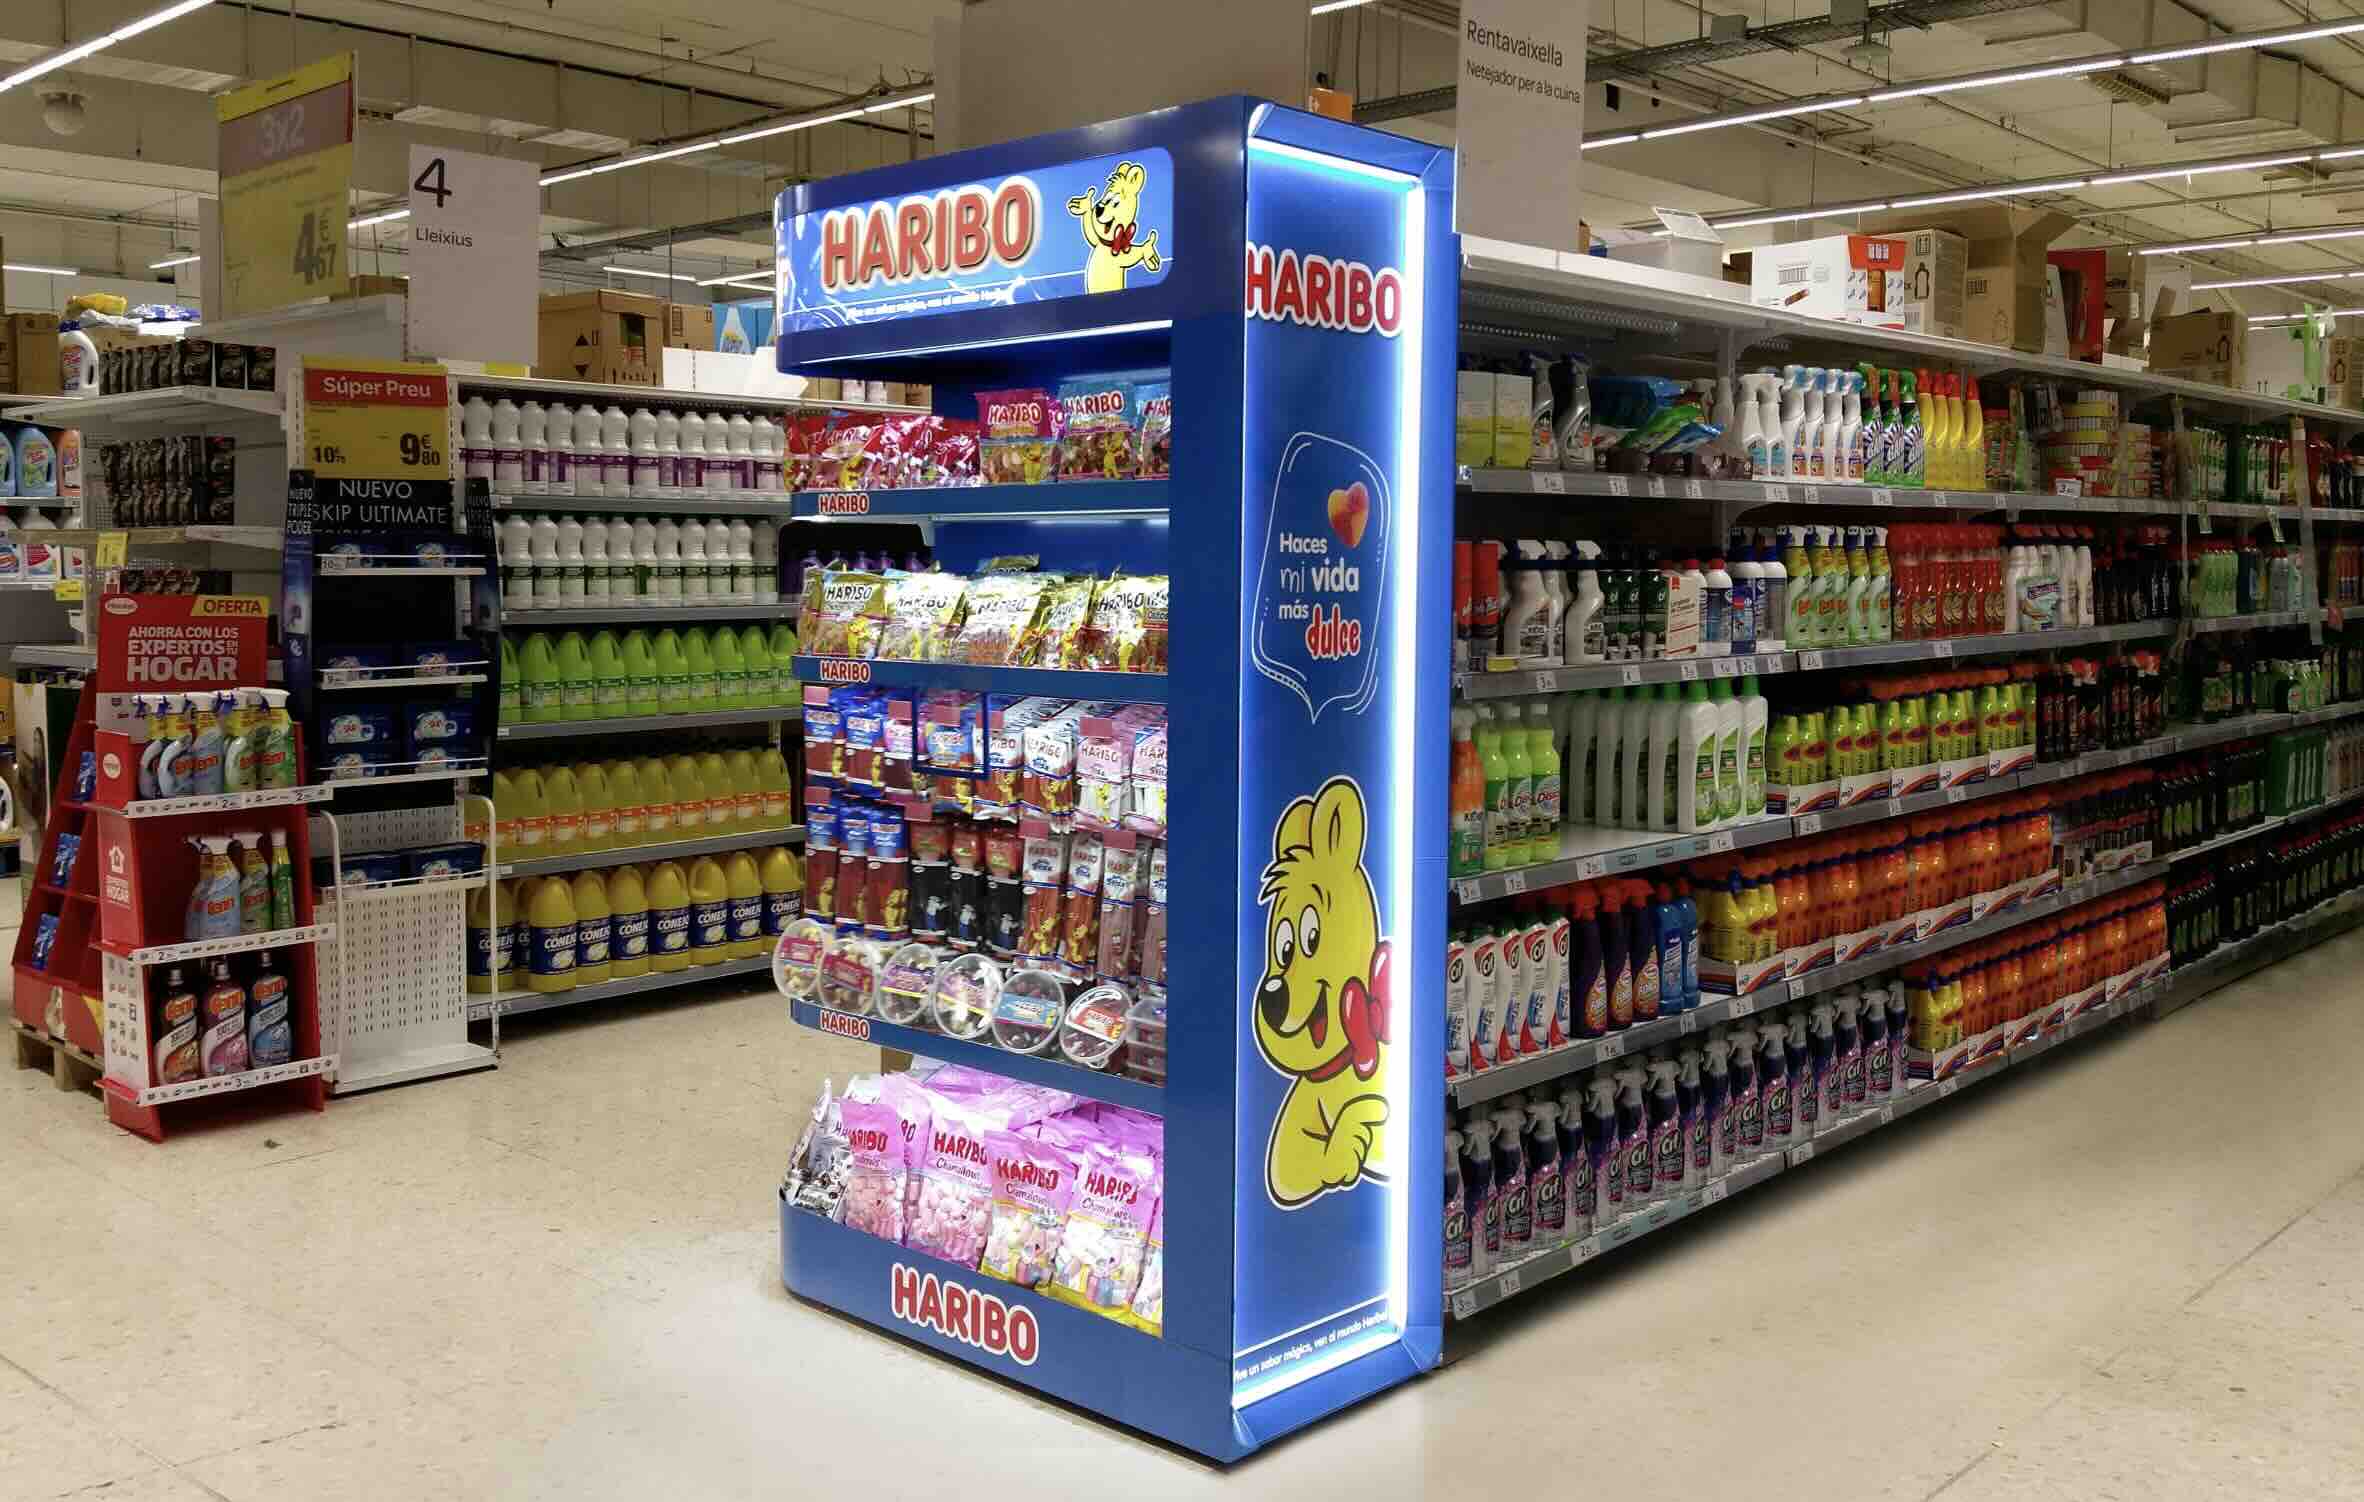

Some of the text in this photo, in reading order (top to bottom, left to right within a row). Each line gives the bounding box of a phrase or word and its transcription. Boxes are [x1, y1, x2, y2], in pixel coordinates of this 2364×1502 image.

[1467, 20, 1563, 67] Rentavaixella
[1466, 59, 1518, 87] Netejador
[1518, 77, 1536, 93] per
[1553, 84, 1581, 104] cuina
[414, 158, 452, 208] 4
[415, 226, 473, 248] Lleixius
[822, 183, 1035, 290] HARIBO
[1247, 246, 1402, 333] HARIBO
[323, 375, 431, 399] Súper Preu
[988, 401, 1041, 424] HARIBO
[1064, 390, 1125, 415] HARIBO
[289, 487, 313, 501] NUEVO
[338, 481, 413, 499] NUEVO
[312, 504, 352, 522] SKIP
[359, 505, 448, 525] ULTIMATE
[819, 494, 869, 513] HARIBO
[1279, 532, 1328, 554] Haces
[1280, 557, 1360, 594] mi vida
[203, 599, 263, 614] OFERTA
[129, 626, 239, 639] AHORRA CON LOS
[1278, 599, 1361, 660] más dulce
[128, 639, 226, 655] EXPERTOS
[127, 656, 239, 682] HOGAR
[820, 660, 870, 682] HARIBO
[820, 1010, 870, 1040] HARIBO
[893, 1264, 1038, 1364] HARIBO
